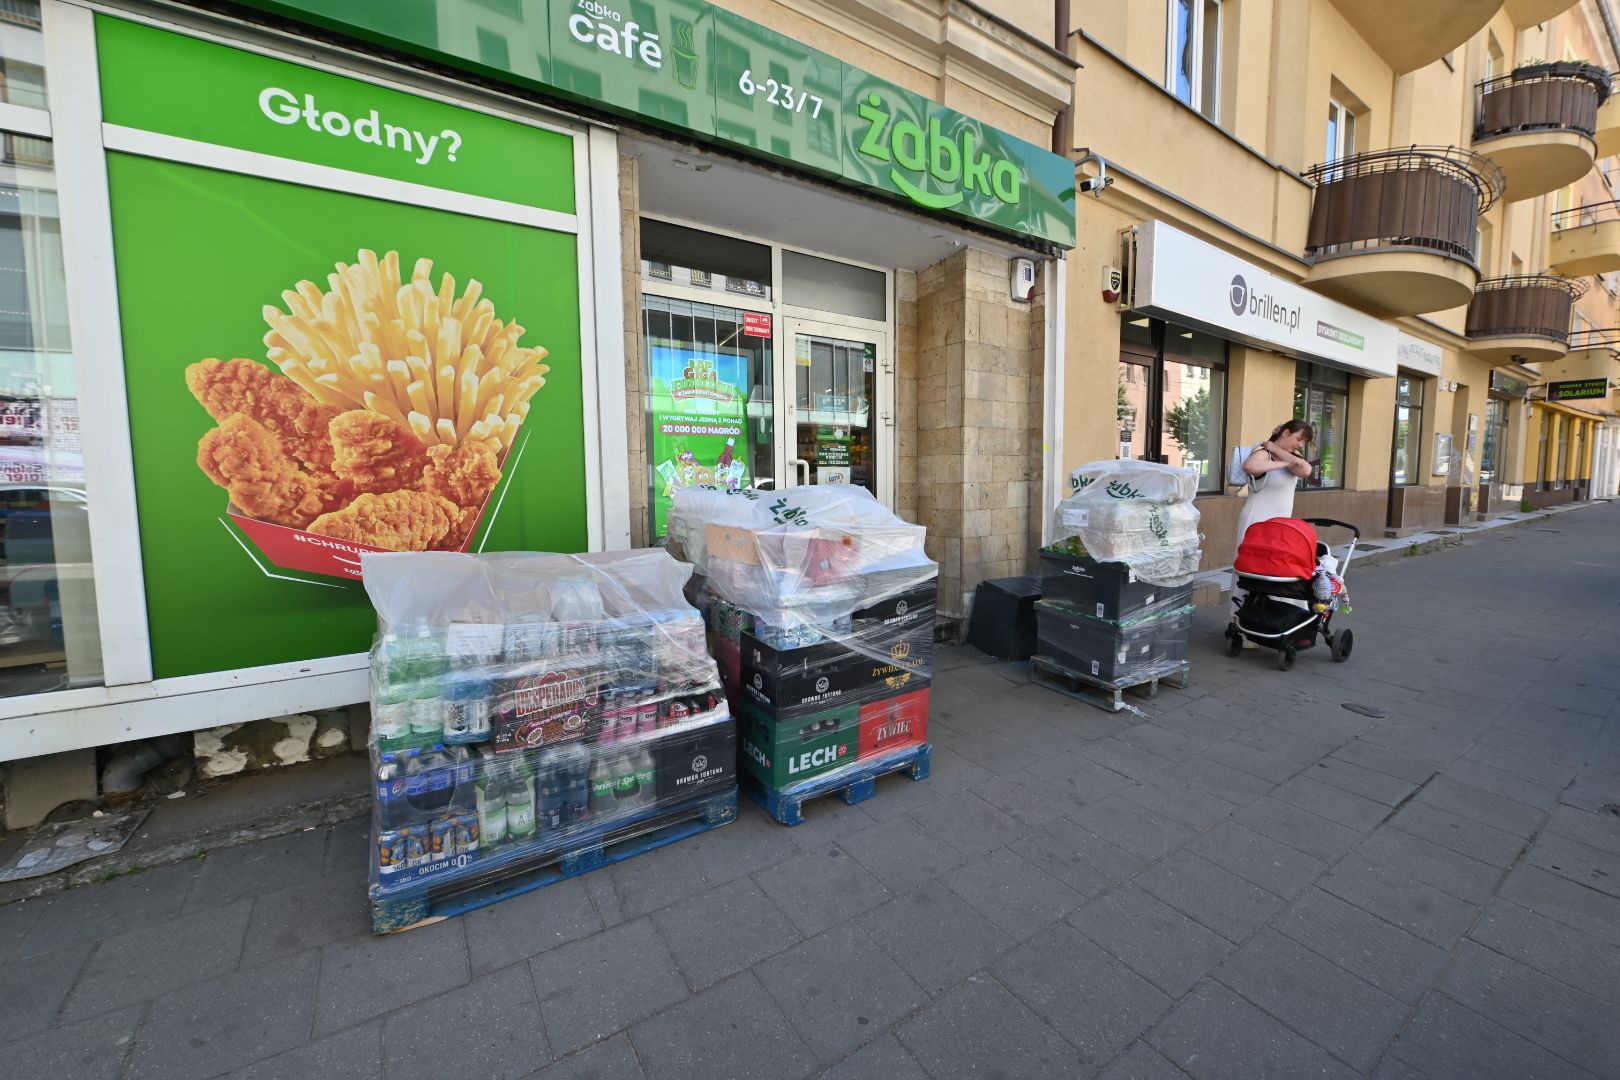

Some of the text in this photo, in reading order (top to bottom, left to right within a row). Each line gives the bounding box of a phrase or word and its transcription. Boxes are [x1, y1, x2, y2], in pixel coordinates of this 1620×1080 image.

[738, 70, 824, 119] 6-23/7
[258, 86, 463, 166] Głodny?
[858, 91, 1020, 205] żabka
[1250, 287, 1301, 334] brillen.pl
[1318, 324, 1338, 339] DYSKONT
[1558, 388, 1605, 398] SOLARIUM
[674, 425, 690, 433] 000
[708, 426, 740, 435] NAGRÓD
[872, 665, 899, 677] ŻYWIEC
[801, 694, 821, 704] BROWAR
[877, 720, 912, 742] ŻYWIEC
[743, 738, 766, 767] LECH
[788, 745, 838, 775] LECH
[676, 773, 699, 786] BROWAR
[700, 767, 723, 778] FORTUNA
[419, 861, 449, 875] OKOCIM
